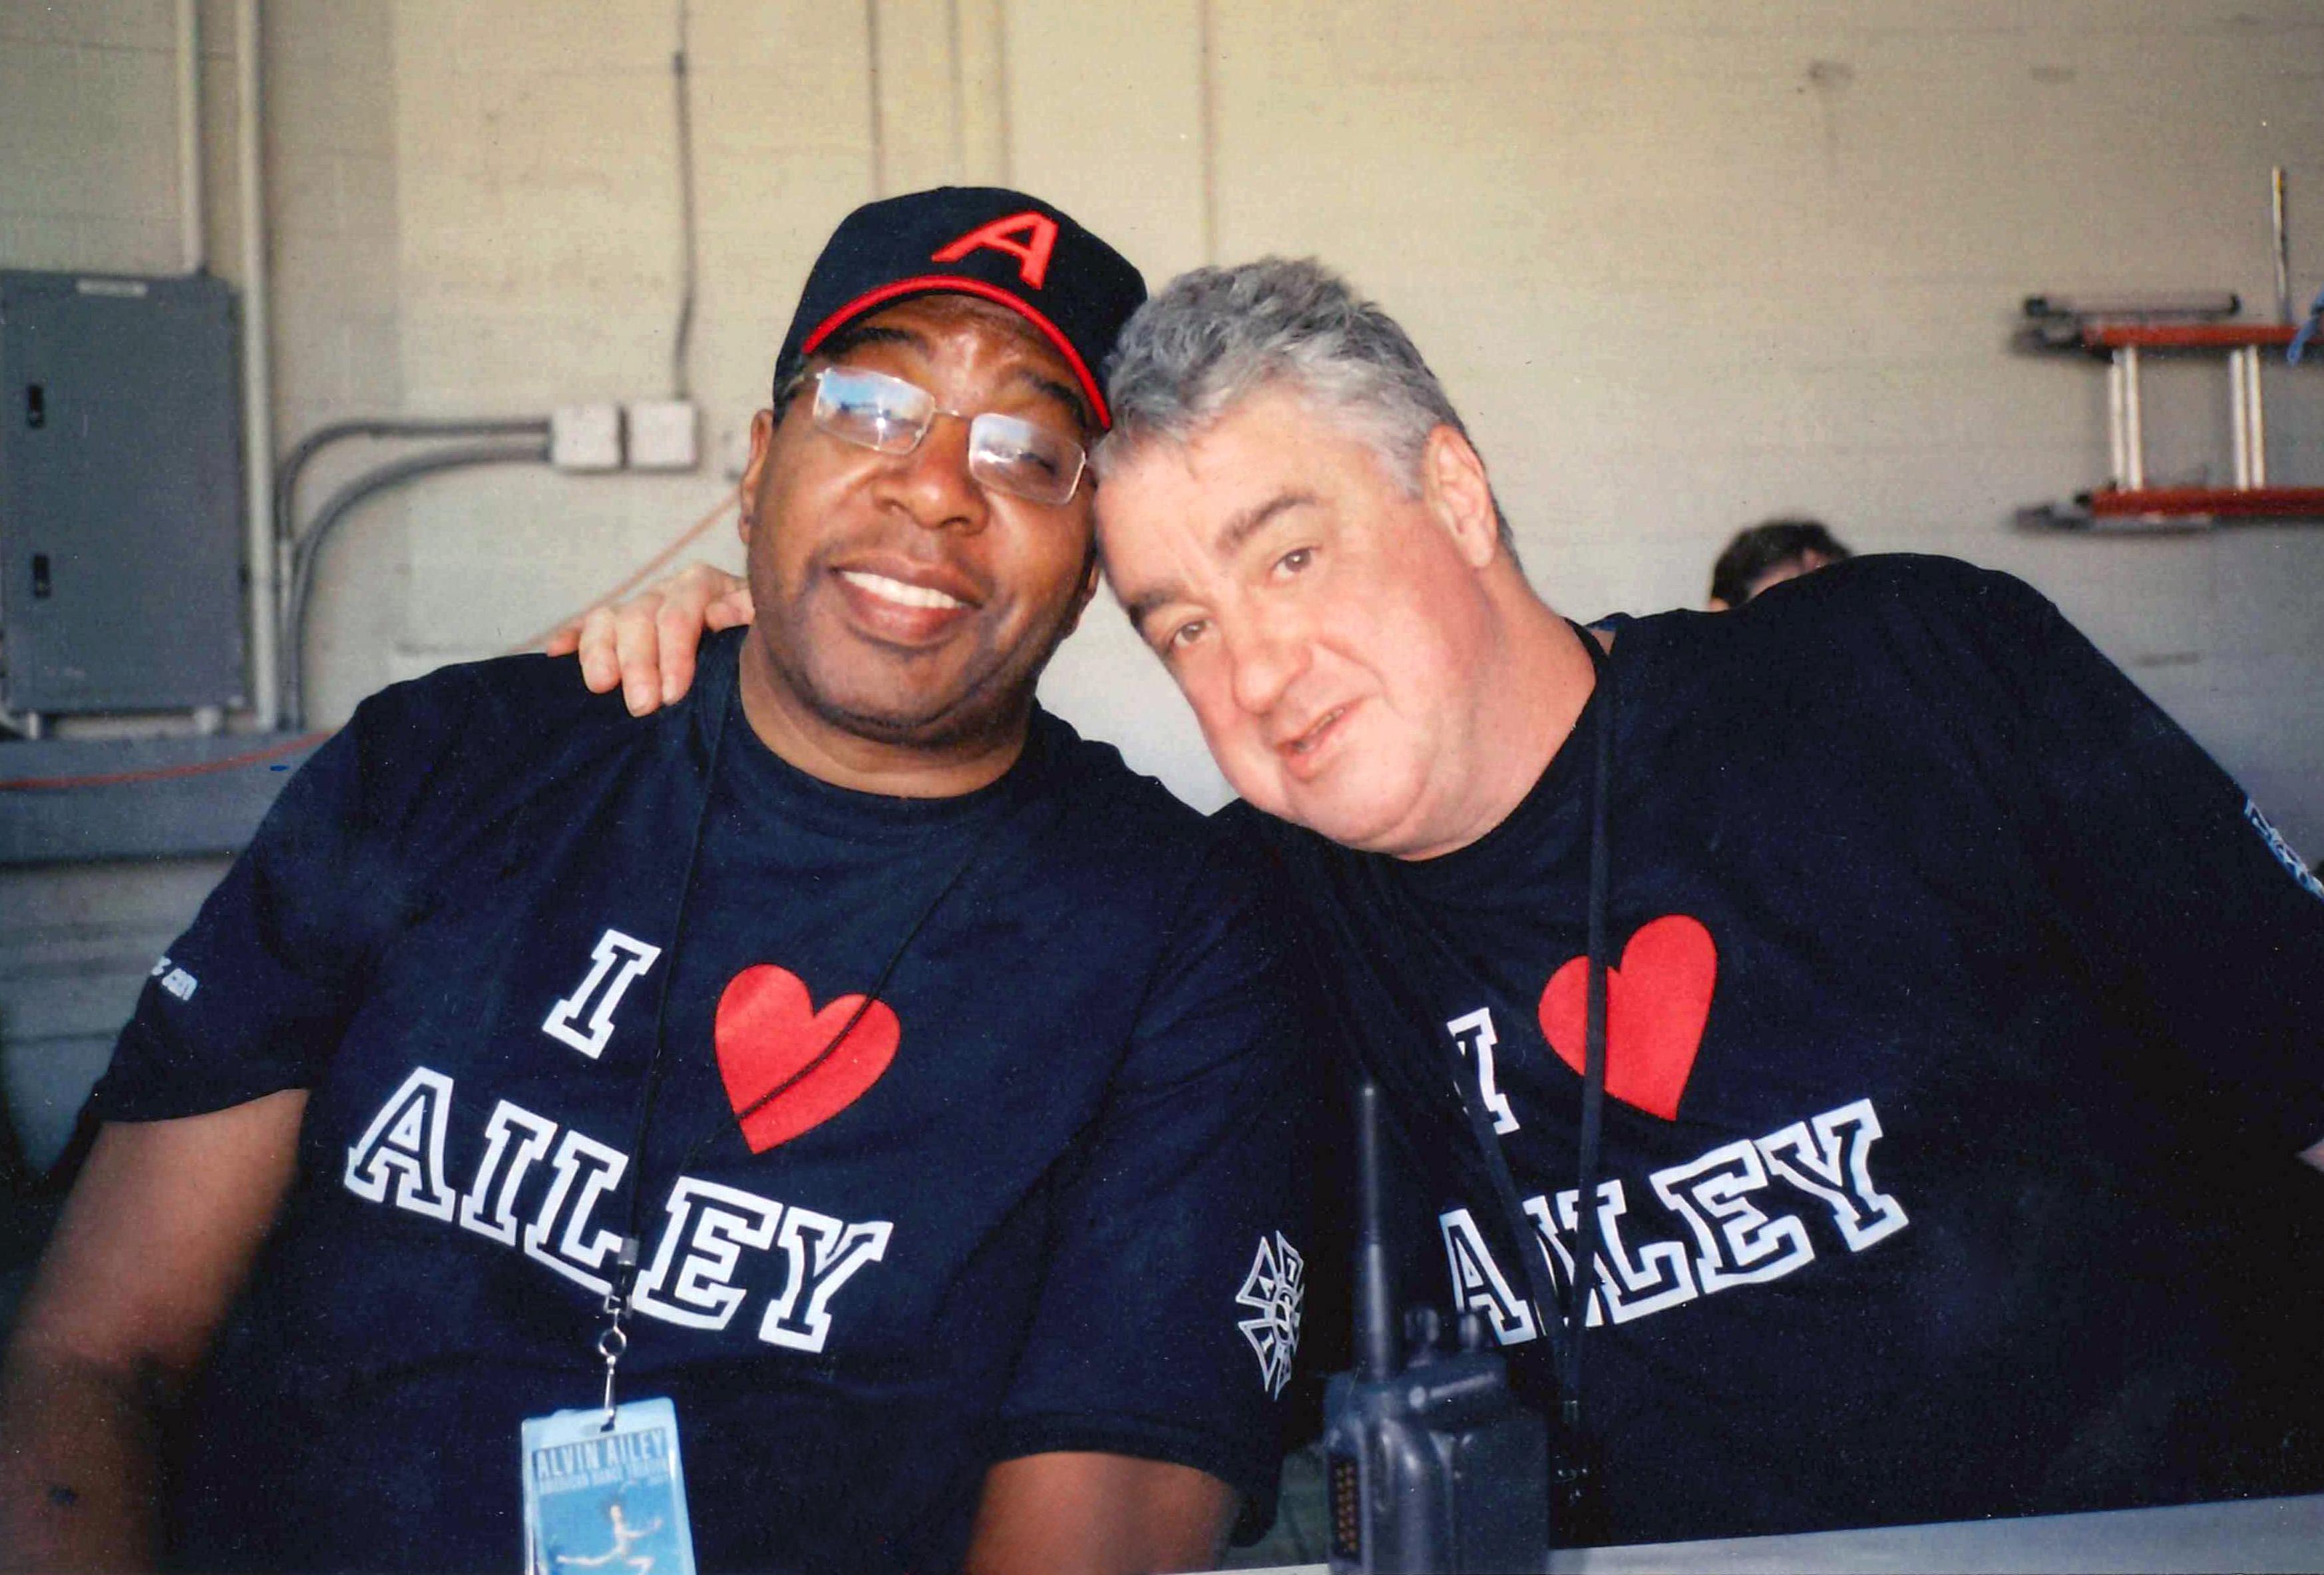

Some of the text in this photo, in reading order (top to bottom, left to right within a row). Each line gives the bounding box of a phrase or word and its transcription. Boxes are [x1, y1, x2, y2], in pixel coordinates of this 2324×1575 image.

[930, 210, 1060, 291] A
[542, 929, 662, 1060] I
[343, 1066, 893, 1353] AILEY
[535, 1441, 600, 1481] ALVIN
[606, 1429, 666, 1467] AILEY
